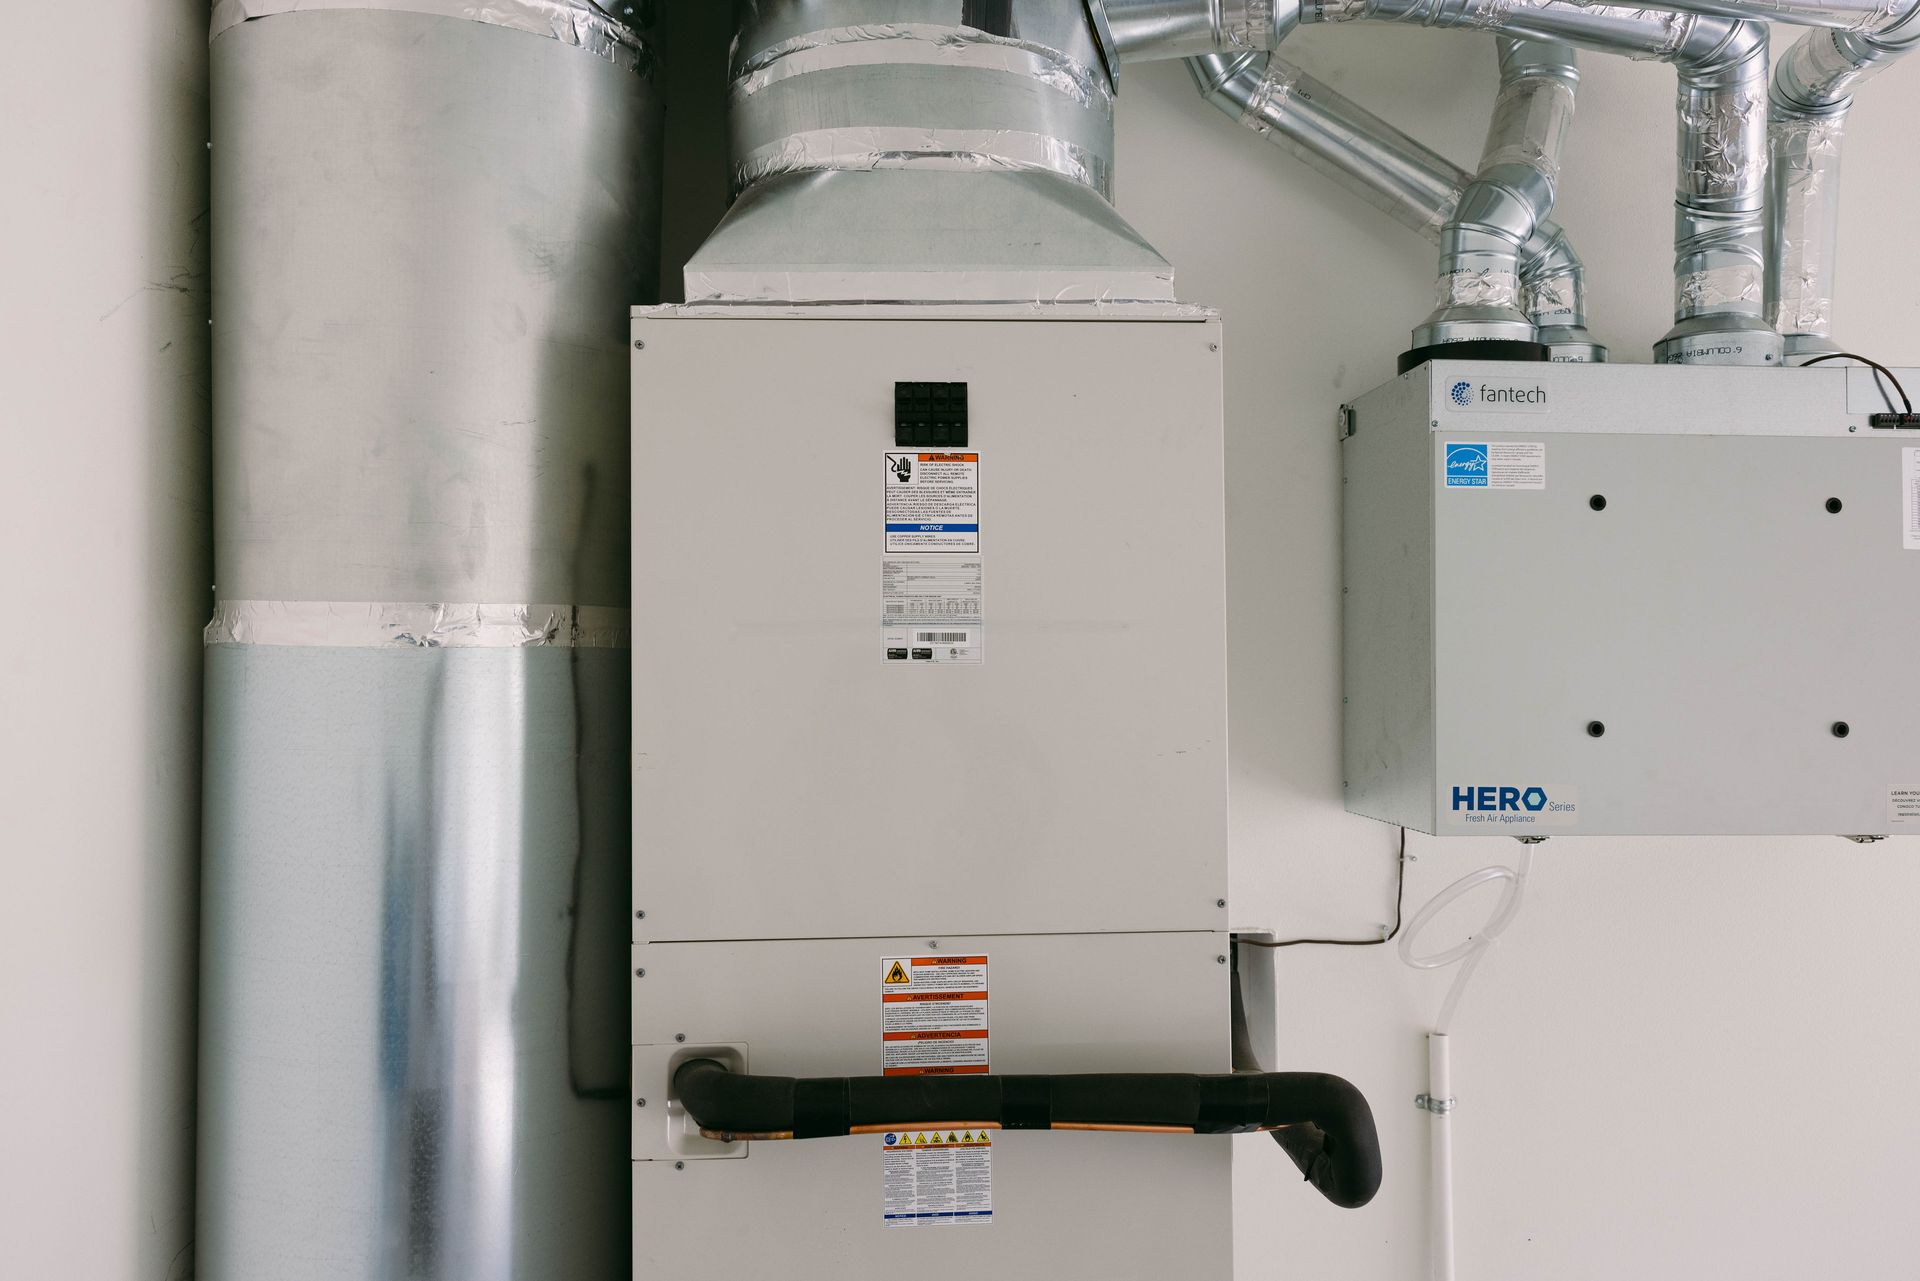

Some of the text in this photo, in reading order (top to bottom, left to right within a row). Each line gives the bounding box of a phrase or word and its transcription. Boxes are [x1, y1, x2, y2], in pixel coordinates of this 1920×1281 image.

[1686, 346, 1732, 357] COLUMBIA
[1480, 384, 1546, 404] fantech
[1452, 786, 1576, 812] HERO Series
[1466, 814, 1536, 824] Fresh Air Appliance
